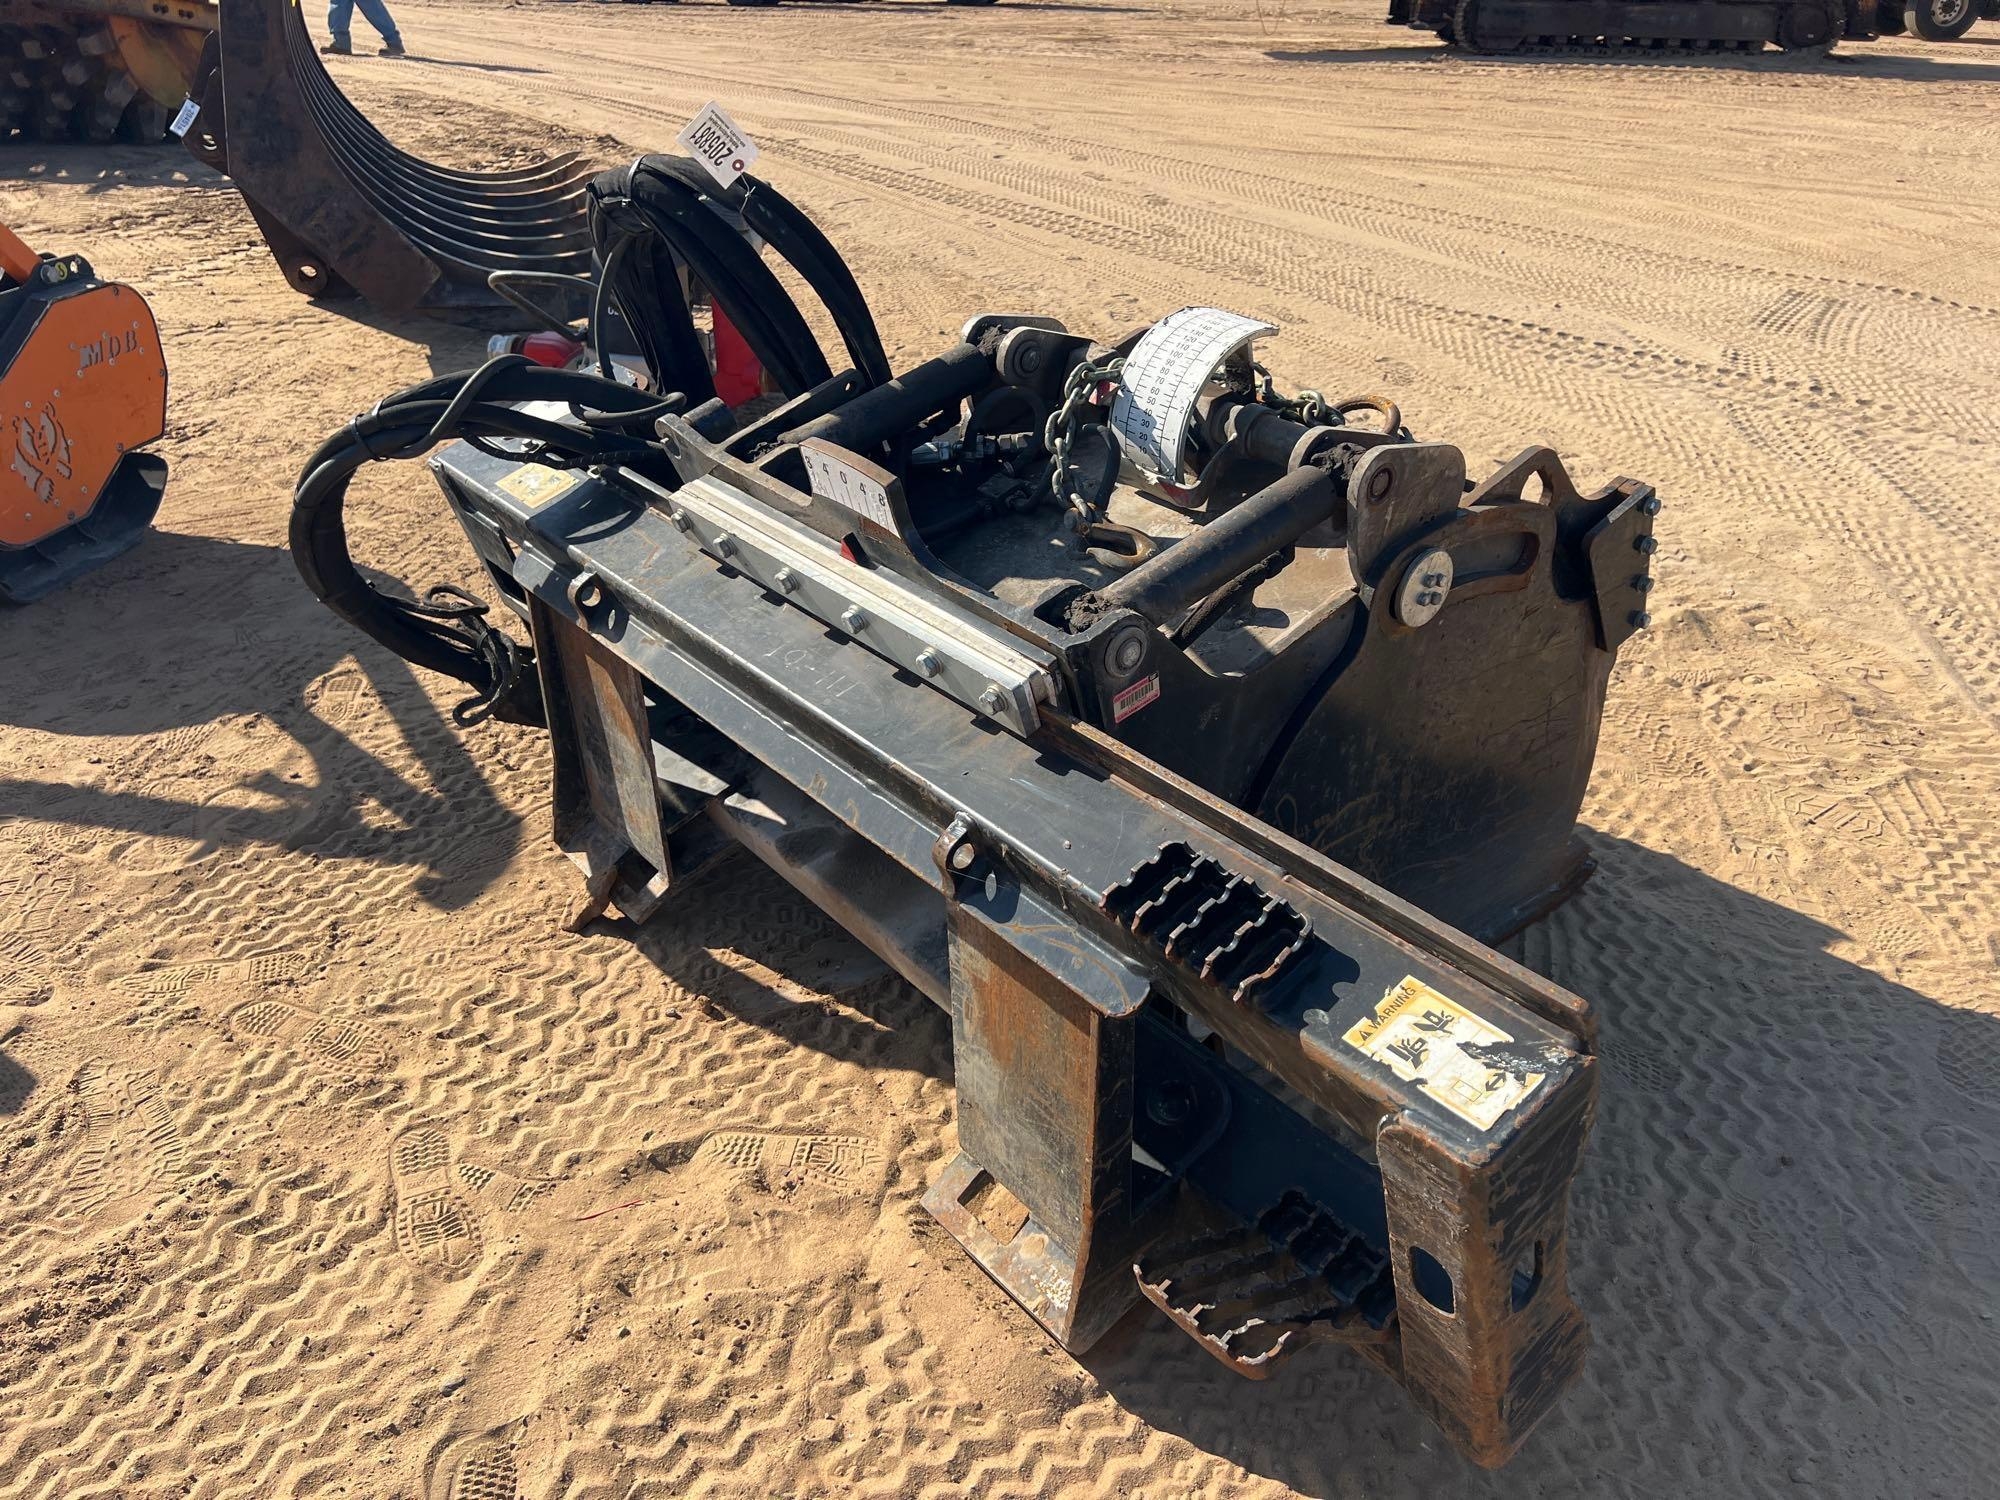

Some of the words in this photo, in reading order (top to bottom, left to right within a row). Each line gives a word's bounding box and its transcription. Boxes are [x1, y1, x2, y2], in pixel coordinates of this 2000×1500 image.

[689, 121, 734, 167] 205881
[1183, 335, 1197, 343] 120
[1176, 342, 1190, 351] 110
[1170, 350, 1183, 359] 100
[1165, 359, 1176, 367] 90
[1160, 366, 1170, 375] 80
[1155, 375, 1165, 385] 70
[1150, 386, 1160, 395] 60
[1146, 396, 1156, 405] 50
[1143, 408, 1153, 417] 40
[1179, 406, 1185, 414] 2
[1141, 419, 1150, 428] 30
[1139, 432, 1148, 441] 20
[1172, 438, 1176, 446] 1
[1139, 446, 1147, 454] 10
[805, 456, 813, 469] 8
[823, 462, 829, 475] 4
[878, 493, 886, 507] 8
[1368, 986, 1416, 1030] WARNING
